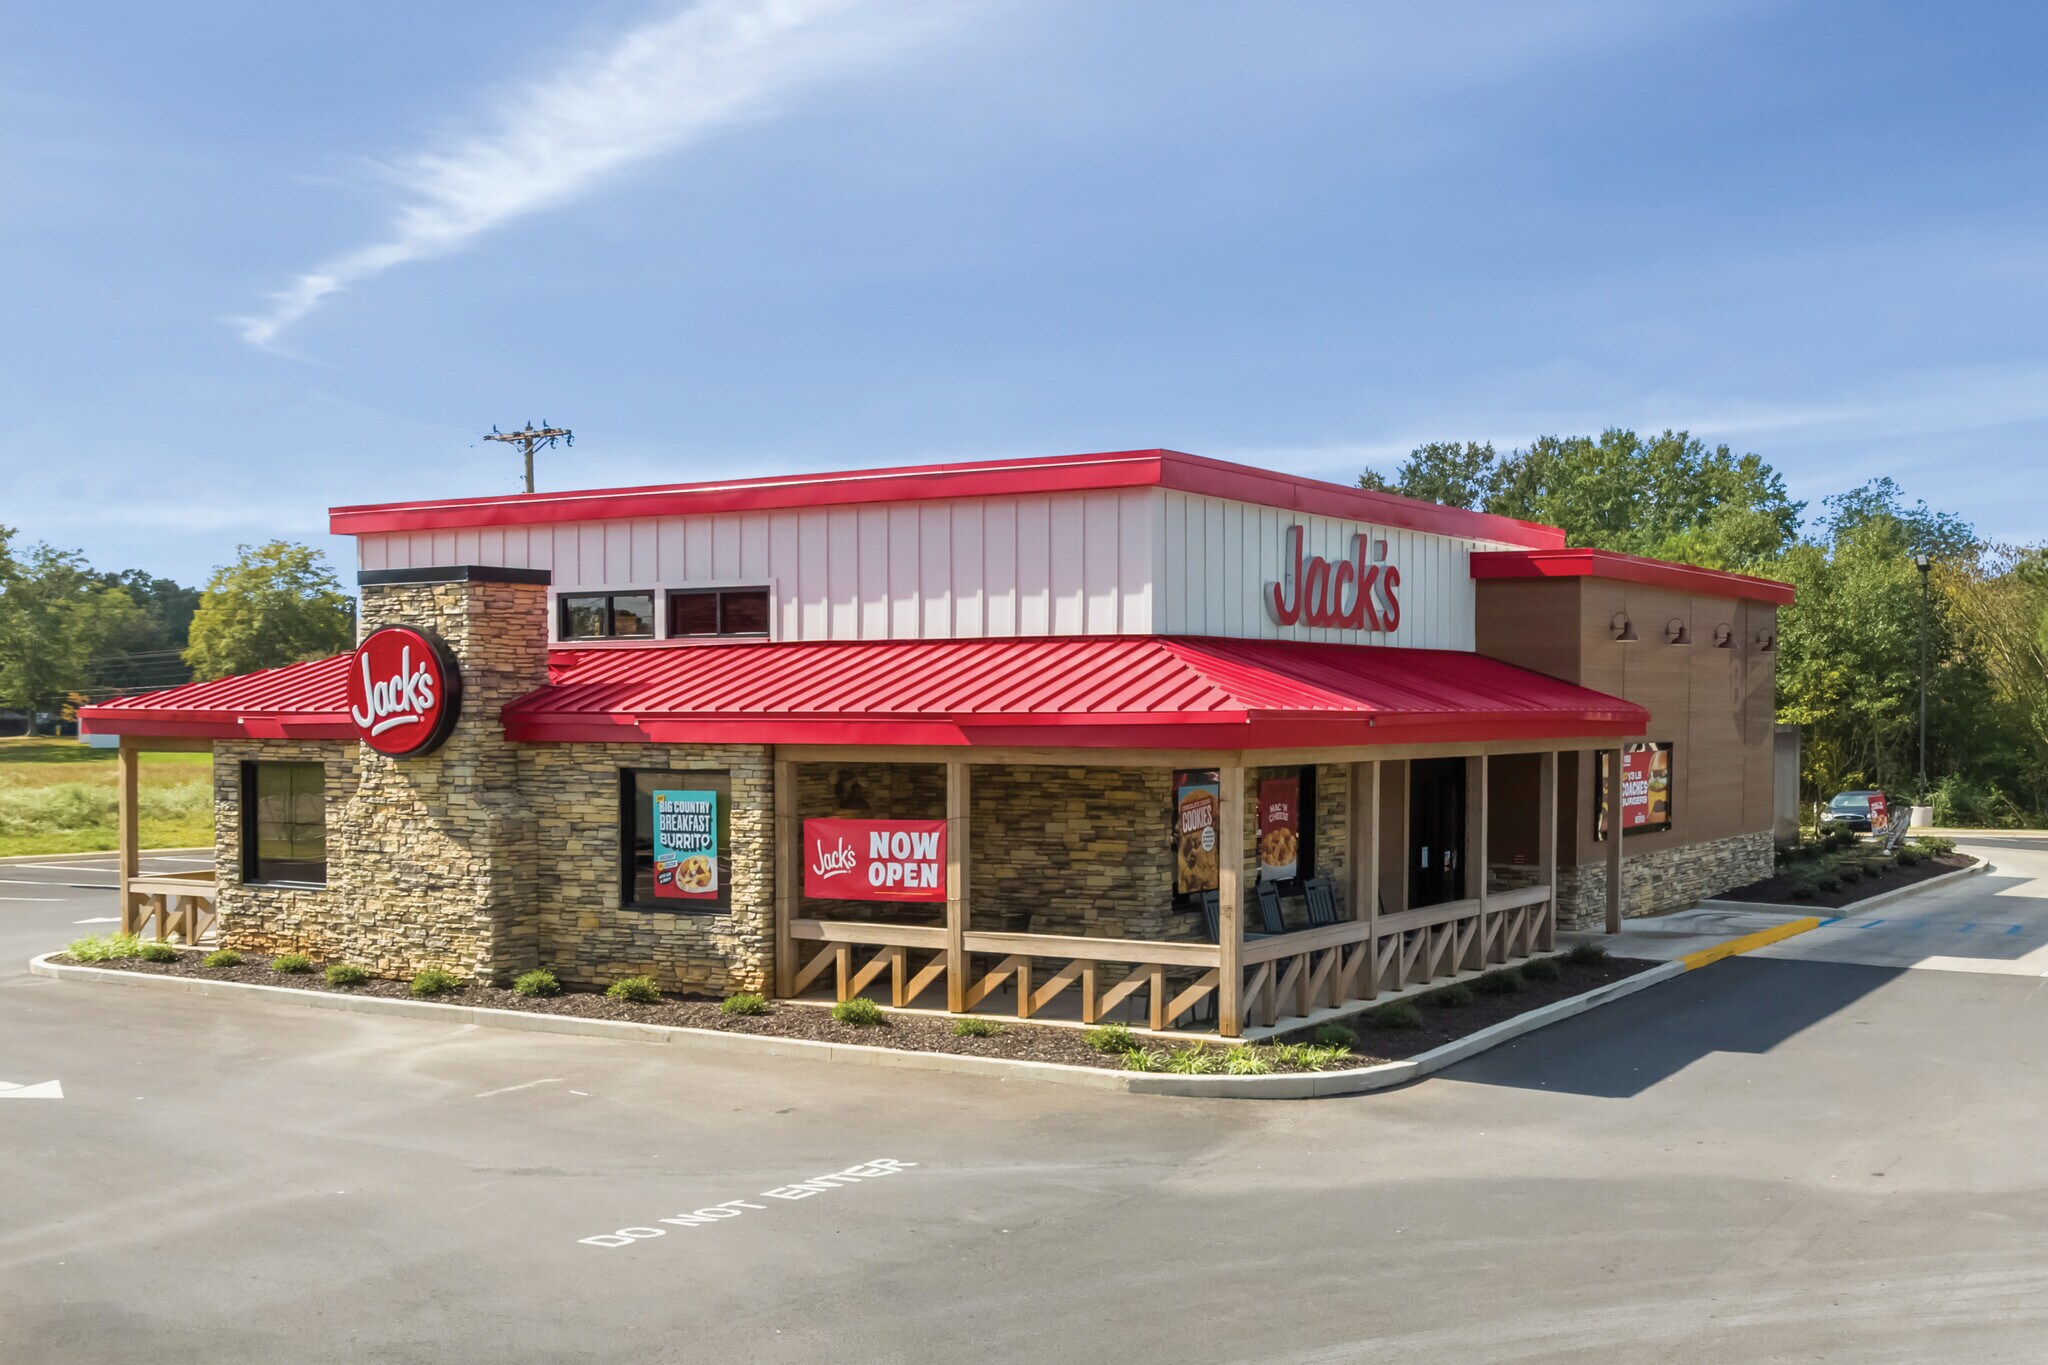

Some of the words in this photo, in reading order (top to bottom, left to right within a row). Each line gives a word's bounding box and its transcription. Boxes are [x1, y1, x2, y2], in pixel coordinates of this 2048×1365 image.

[1264, 525, 1400, 632] Jack's
[352, 645, 434, 729] Jack's
[659, 801, 673, 813] BIG
[674, 801, 710, 814] COUNTRY
[1182, 804, 1213, 833] COOKIES
[1269, 811, 1289, 823] CHEESE
[1270, 803, 1281, 813] MAC
[660, 814, 711, 832] BREAKFAST
[660, 833, 711, 849] BURRITO
[869, 831, 940, 860] NOW
[812, 837, 857, 875] Jack's
[868, 861, 939, 888] OPEN
[577, 1227, 666, 1247] DO
[658, 1199, 767, 1227] NOT
[760, 1158, 919, 1201] ENTER
